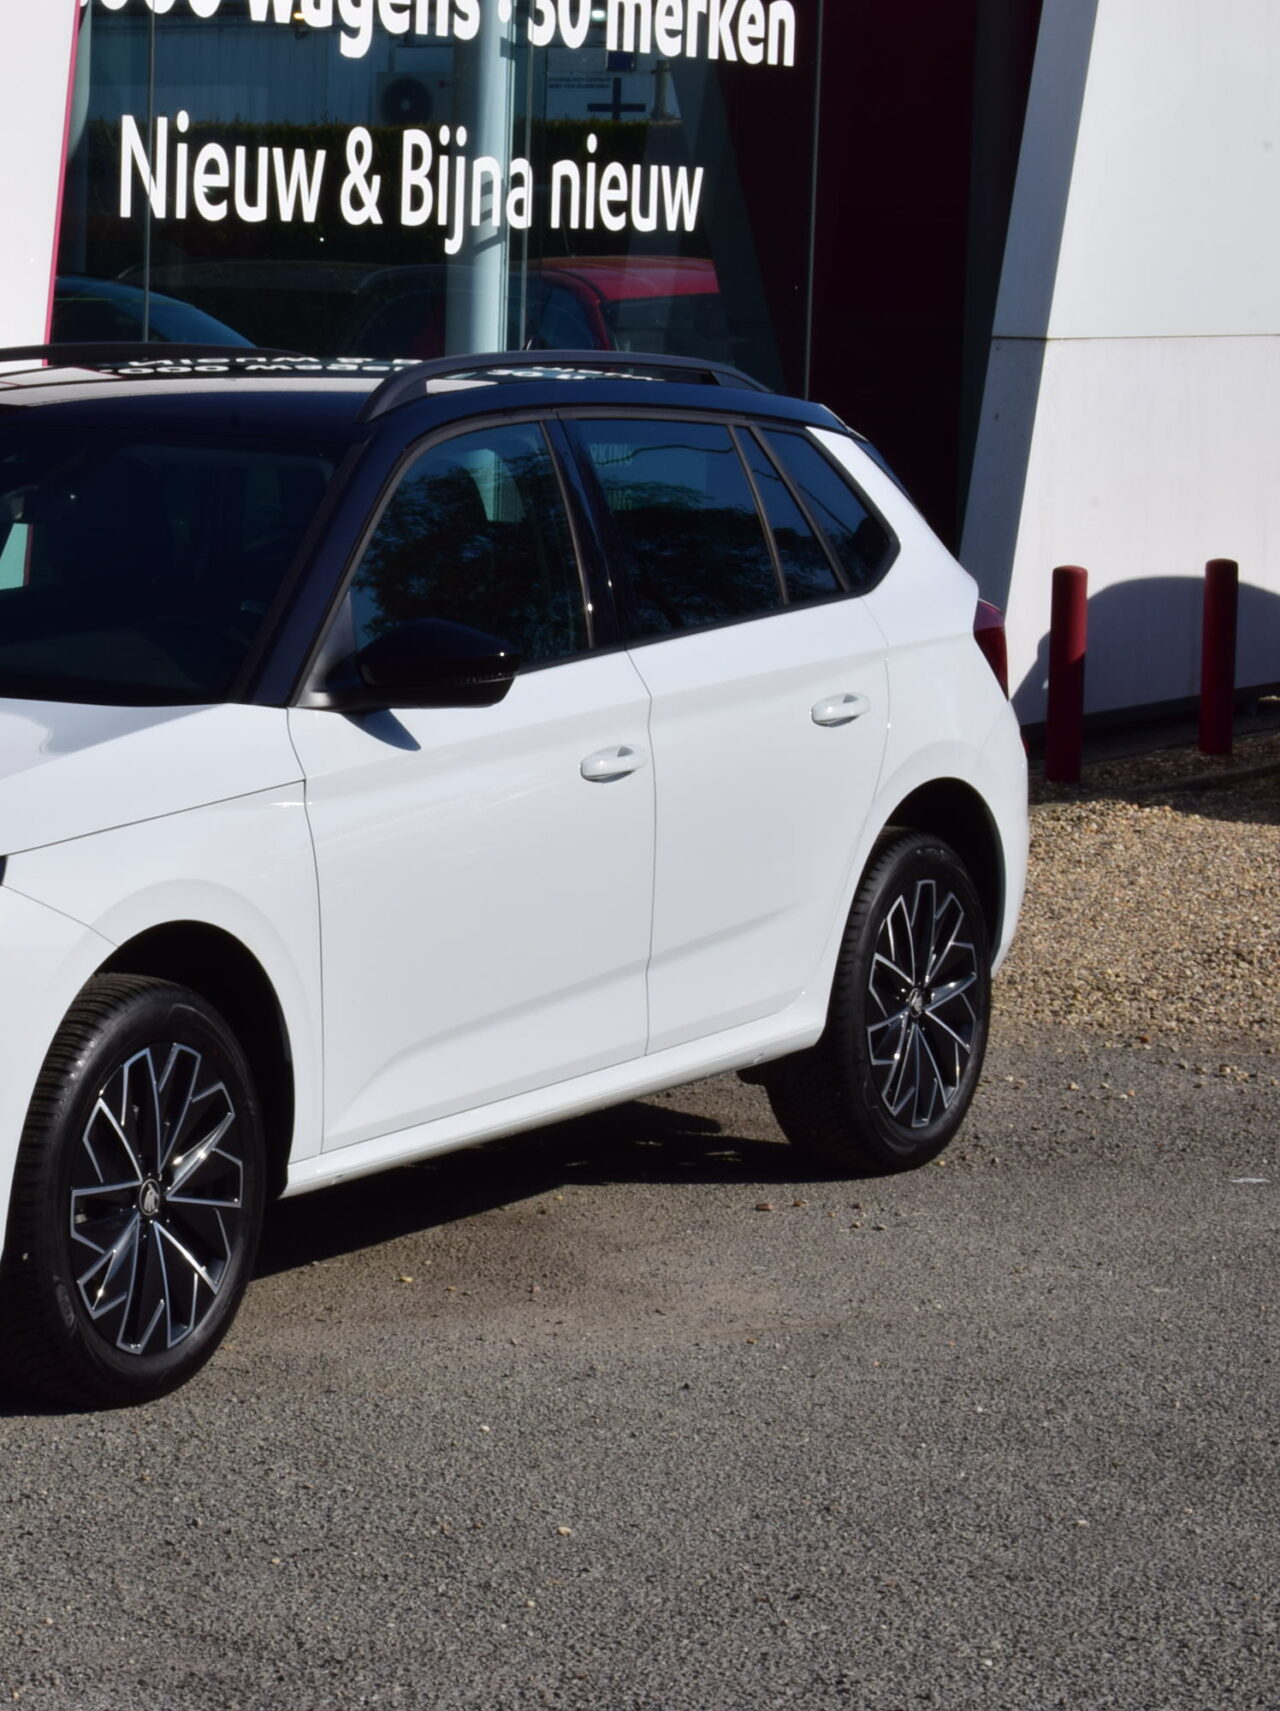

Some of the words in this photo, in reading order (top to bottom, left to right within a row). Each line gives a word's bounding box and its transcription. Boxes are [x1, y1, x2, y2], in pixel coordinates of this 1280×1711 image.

[606, 0, 796, 67] merken
[120, 111, 326, 223] Nieuw
[340, 126, 383, 226] &
[401, 127, 532, 255] Bijna
[550, 133, 704, 232] nieuw
